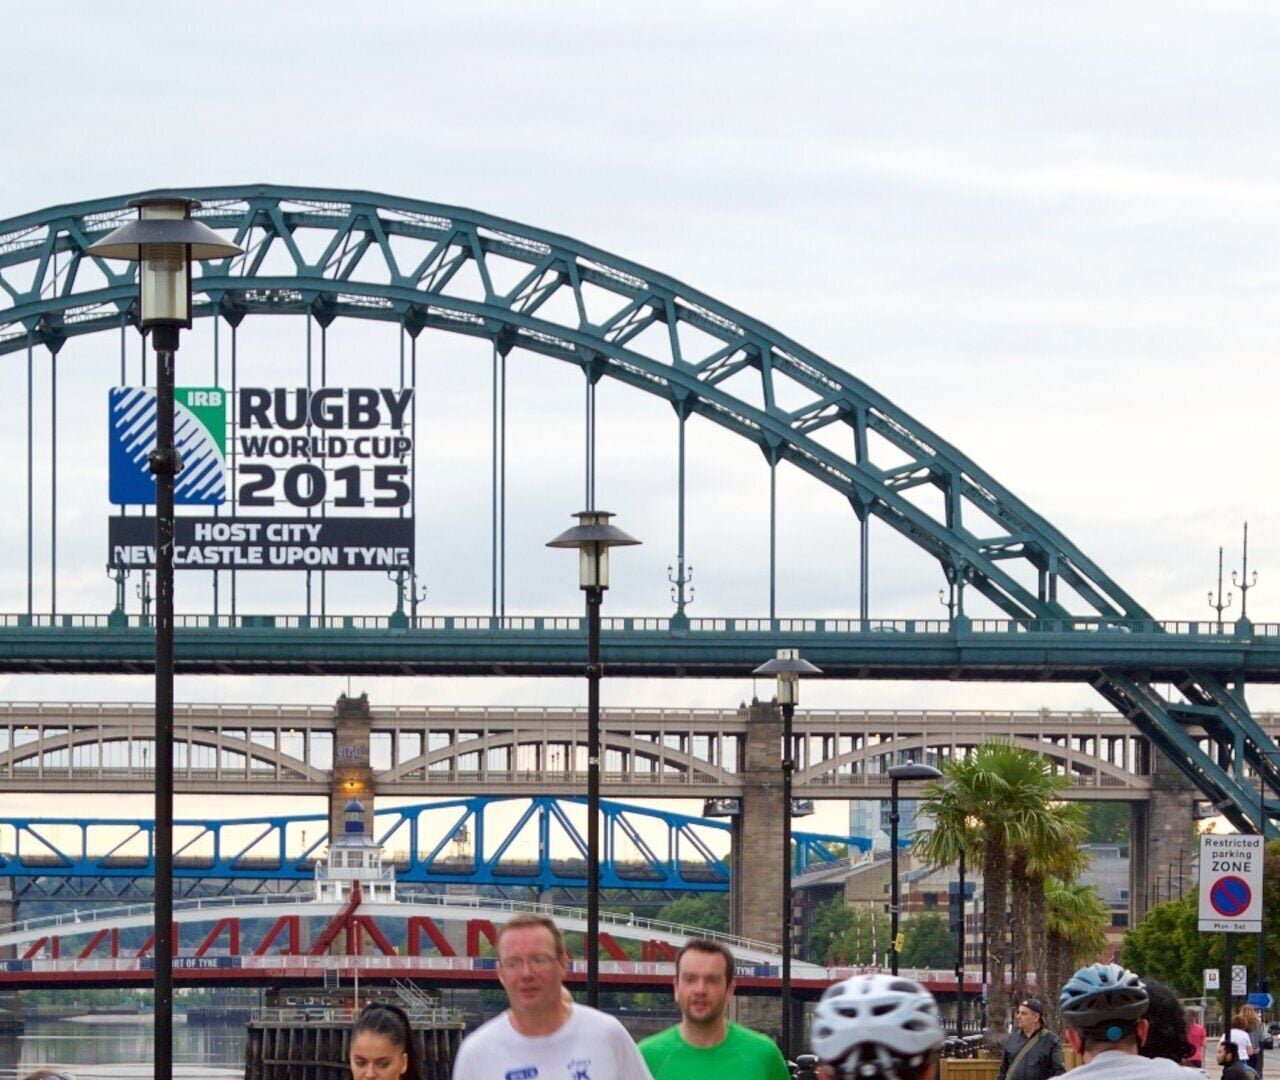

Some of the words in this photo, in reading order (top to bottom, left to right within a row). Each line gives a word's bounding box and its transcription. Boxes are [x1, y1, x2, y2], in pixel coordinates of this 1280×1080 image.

[188, 391, 222, 407] IRB
[238, 387, 415, 430] RUGBY
[241, 435, 347, 458] WORLD
[353, 435, 412, 458] CUP
[238, 463, 410, 508] 2015
[194, 523, 261, 542] HOST
[266, 523, 322, 542] CITY
[269, 546, 338, 565] UPON
[343, 547, 410, 566] TYNE
[1204, 838, 1260, 848] Restricted
[1212, 850, 1252, 860] parking
[1211, 861, 1252, 872] ZONE
[186, 958, 197, 968] OF
[198, 958, 218, 968] TYNE
[736, 966, 756, 976] TYNE
